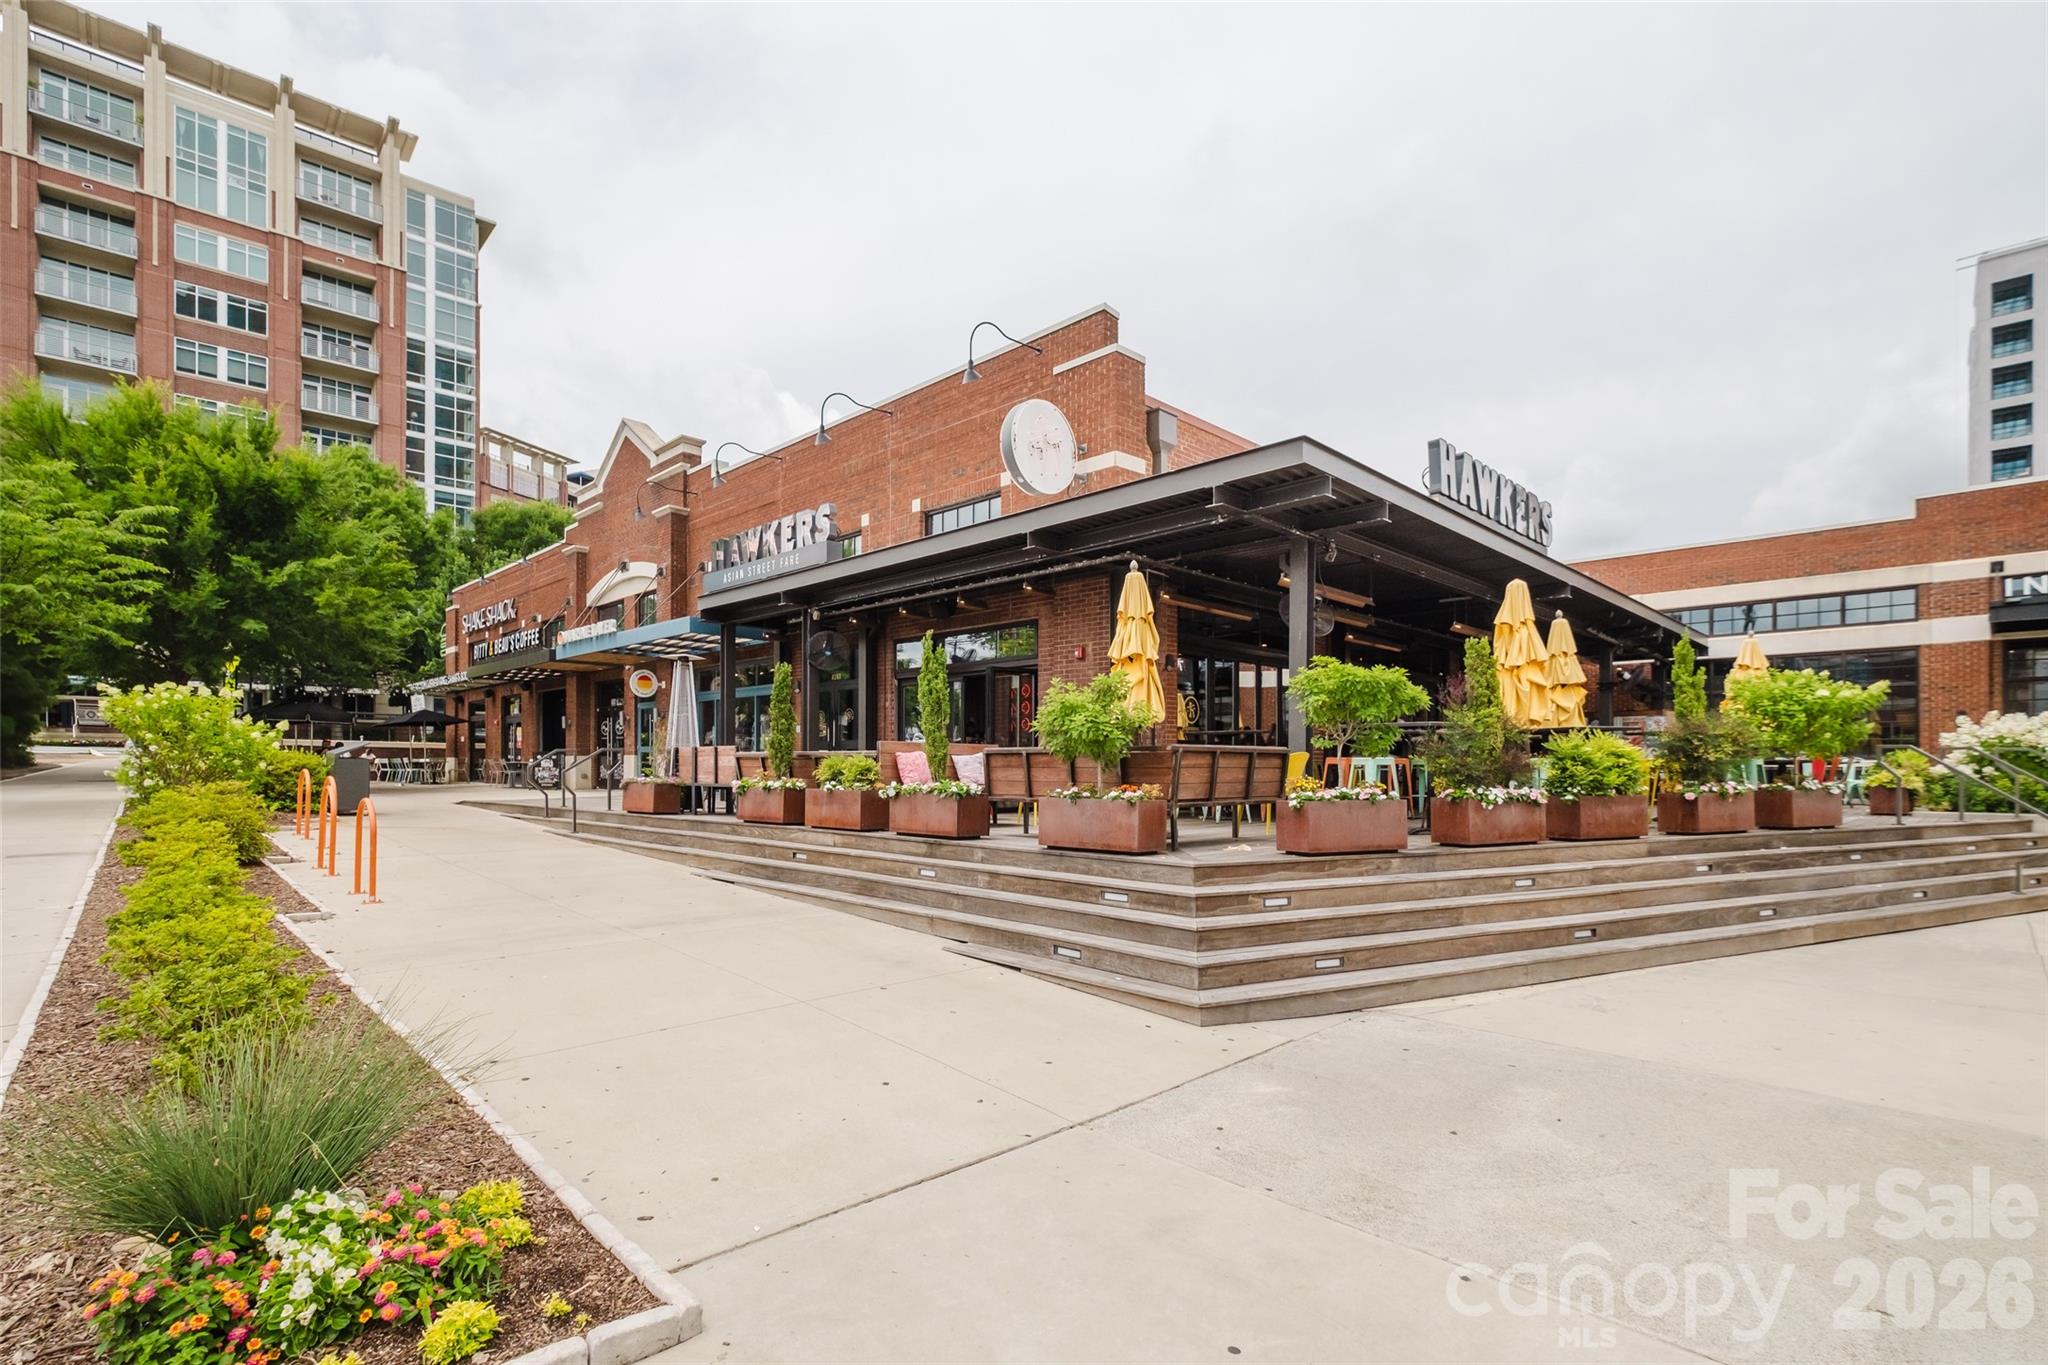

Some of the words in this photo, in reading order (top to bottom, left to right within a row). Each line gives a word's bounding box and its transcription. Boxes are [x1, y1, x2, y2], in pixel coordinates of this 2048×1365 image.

[1430, 437, 1553, 547] HAWKERS
[711, 502, 838, 573] HAWKERS
[722, 566, 745, 584] ASIAN
[747, 559, 777, 577] STREET
[779, 553, 801, 568] FARE
[462, 607, 488, 634] SHAKE
[486, 598, 516, 627] SHACK
[473, 641, 488, 661] BITTY
[488, 640, 494, 657] &
[494, 634, 514, 655] BEAU'S
[515, 628, 540, 650] COFFEE
